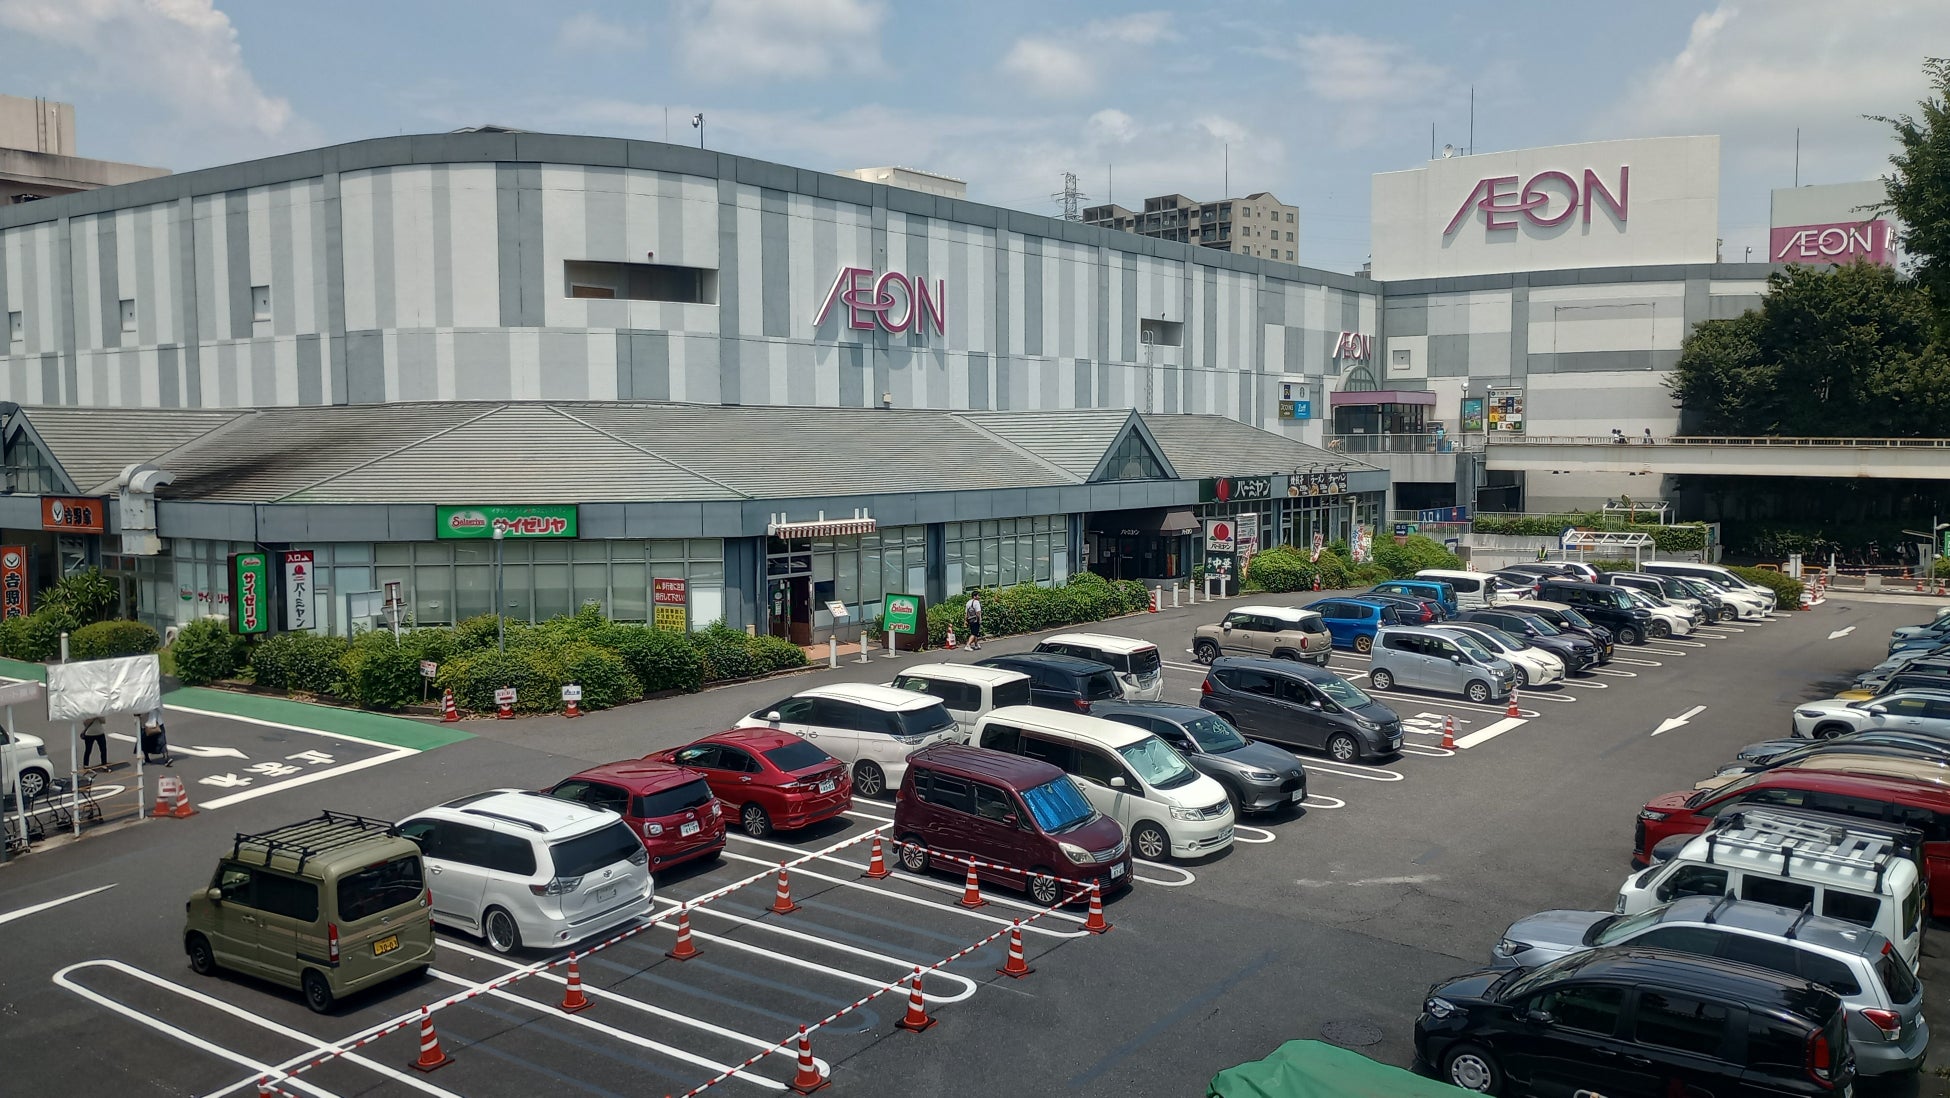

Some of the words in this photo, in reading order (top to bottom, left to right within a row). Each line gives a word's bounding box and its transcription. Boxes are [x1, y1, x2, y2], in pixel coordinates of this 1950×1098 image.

[1443, 166, 1629, 234] AEON
[1777, 226, 1872, 258] AEON
[813, 267, 945, 336] AEON
[1332, 332, 1370, 360] AEON
[1310, 474, 1325, 484] ラーメン
[1328, 473, 1346, 483] チャーハン
[1234, 480, 1271, 498] バーミヤン
[63, 506, 93, 526] 吉野家
[493, 517, 567, 535] サイゼリヤ
[287, 554, 300, 562] 入口
[1212, 557, 1232, 570] 中華
[243, 572, 257, 629] サイゼリヤ
[293, 582, 305, 628] バーミヤン
